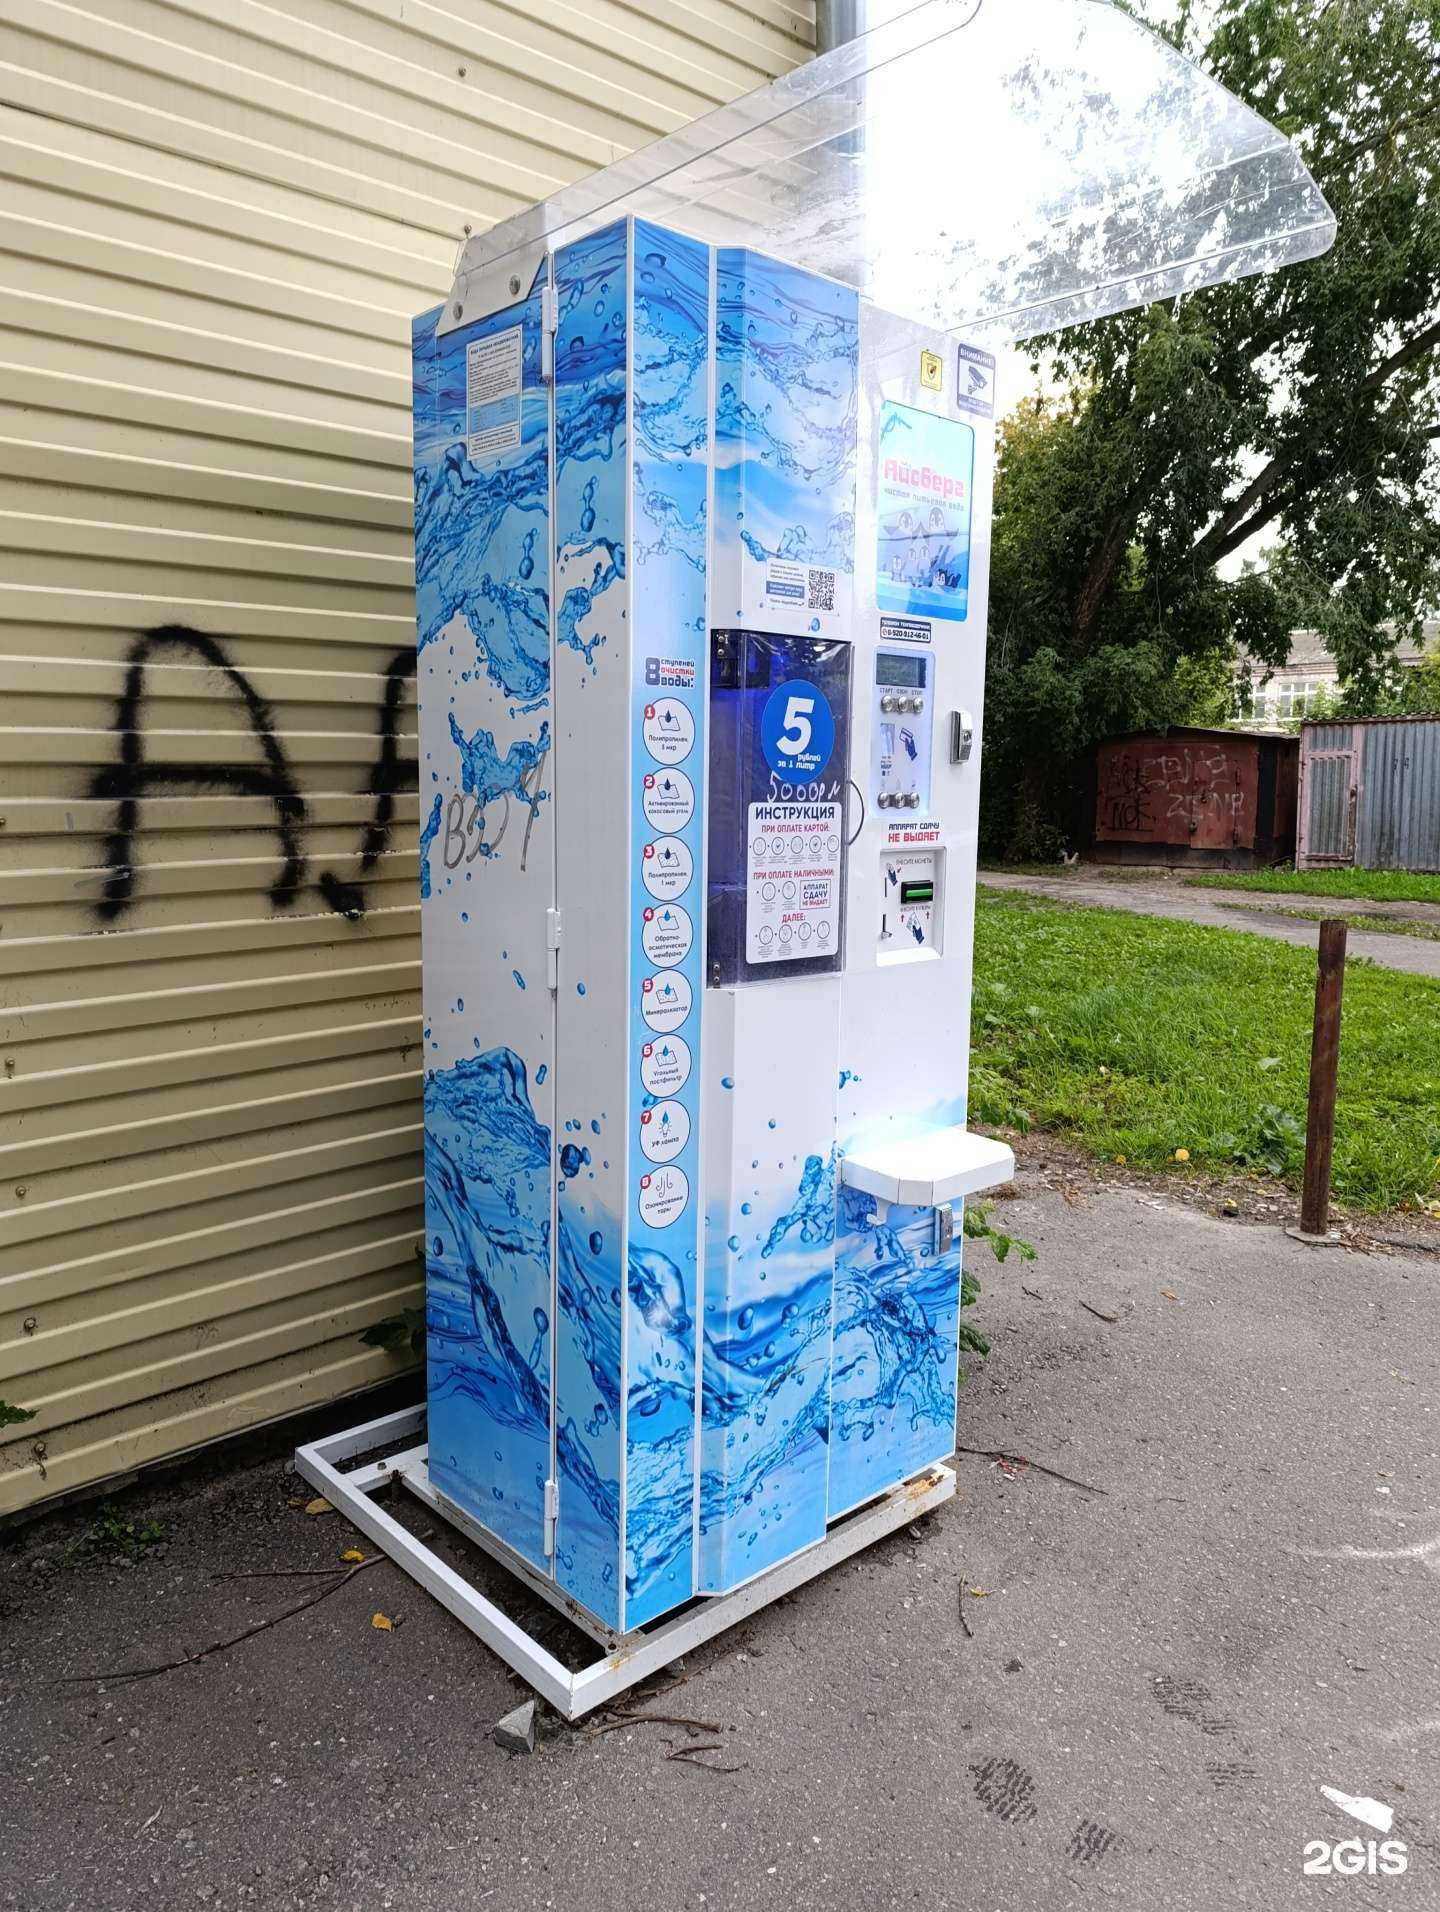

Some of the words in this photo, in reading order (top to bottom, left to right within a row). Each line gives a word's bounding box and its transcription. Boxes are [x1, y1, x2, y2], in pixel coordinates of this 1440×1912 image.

[884, 459, 964, 499] Айсберг
[645, 657, 660, 686] 8
[661, 658, 695, 667] ступеней
[661, 666, 695, 676] очистки
[661, 675, 694, 688] воды:
[776, 696, 815, 756] 5
[797, 752, 821, 762] рублей
[777, 760, 786, 768] за
[796, 761, 815, 771] литр
[755, 806, 835, 821] ИНСТРУКЦИЯ
[761, 824, 775, 833] ПРИ
[777, 824, 803, 833] ОПЛАТЕ
[888, 823, 918, 831] АППАРАТ
[919, 822, 940, 830] СДАЧУ
[888, 832, 900, 843] НЕ
[903, 831, 940, 842] ВЫДАЕТ
[753, 871, 767, 880] ПРИ
[768, 870, 792, 879] ОПЛАТЕ
[803, 891, 828, 900] СДАЧУ
[782, 913, 806, 923] ДАЛЕЕ:
